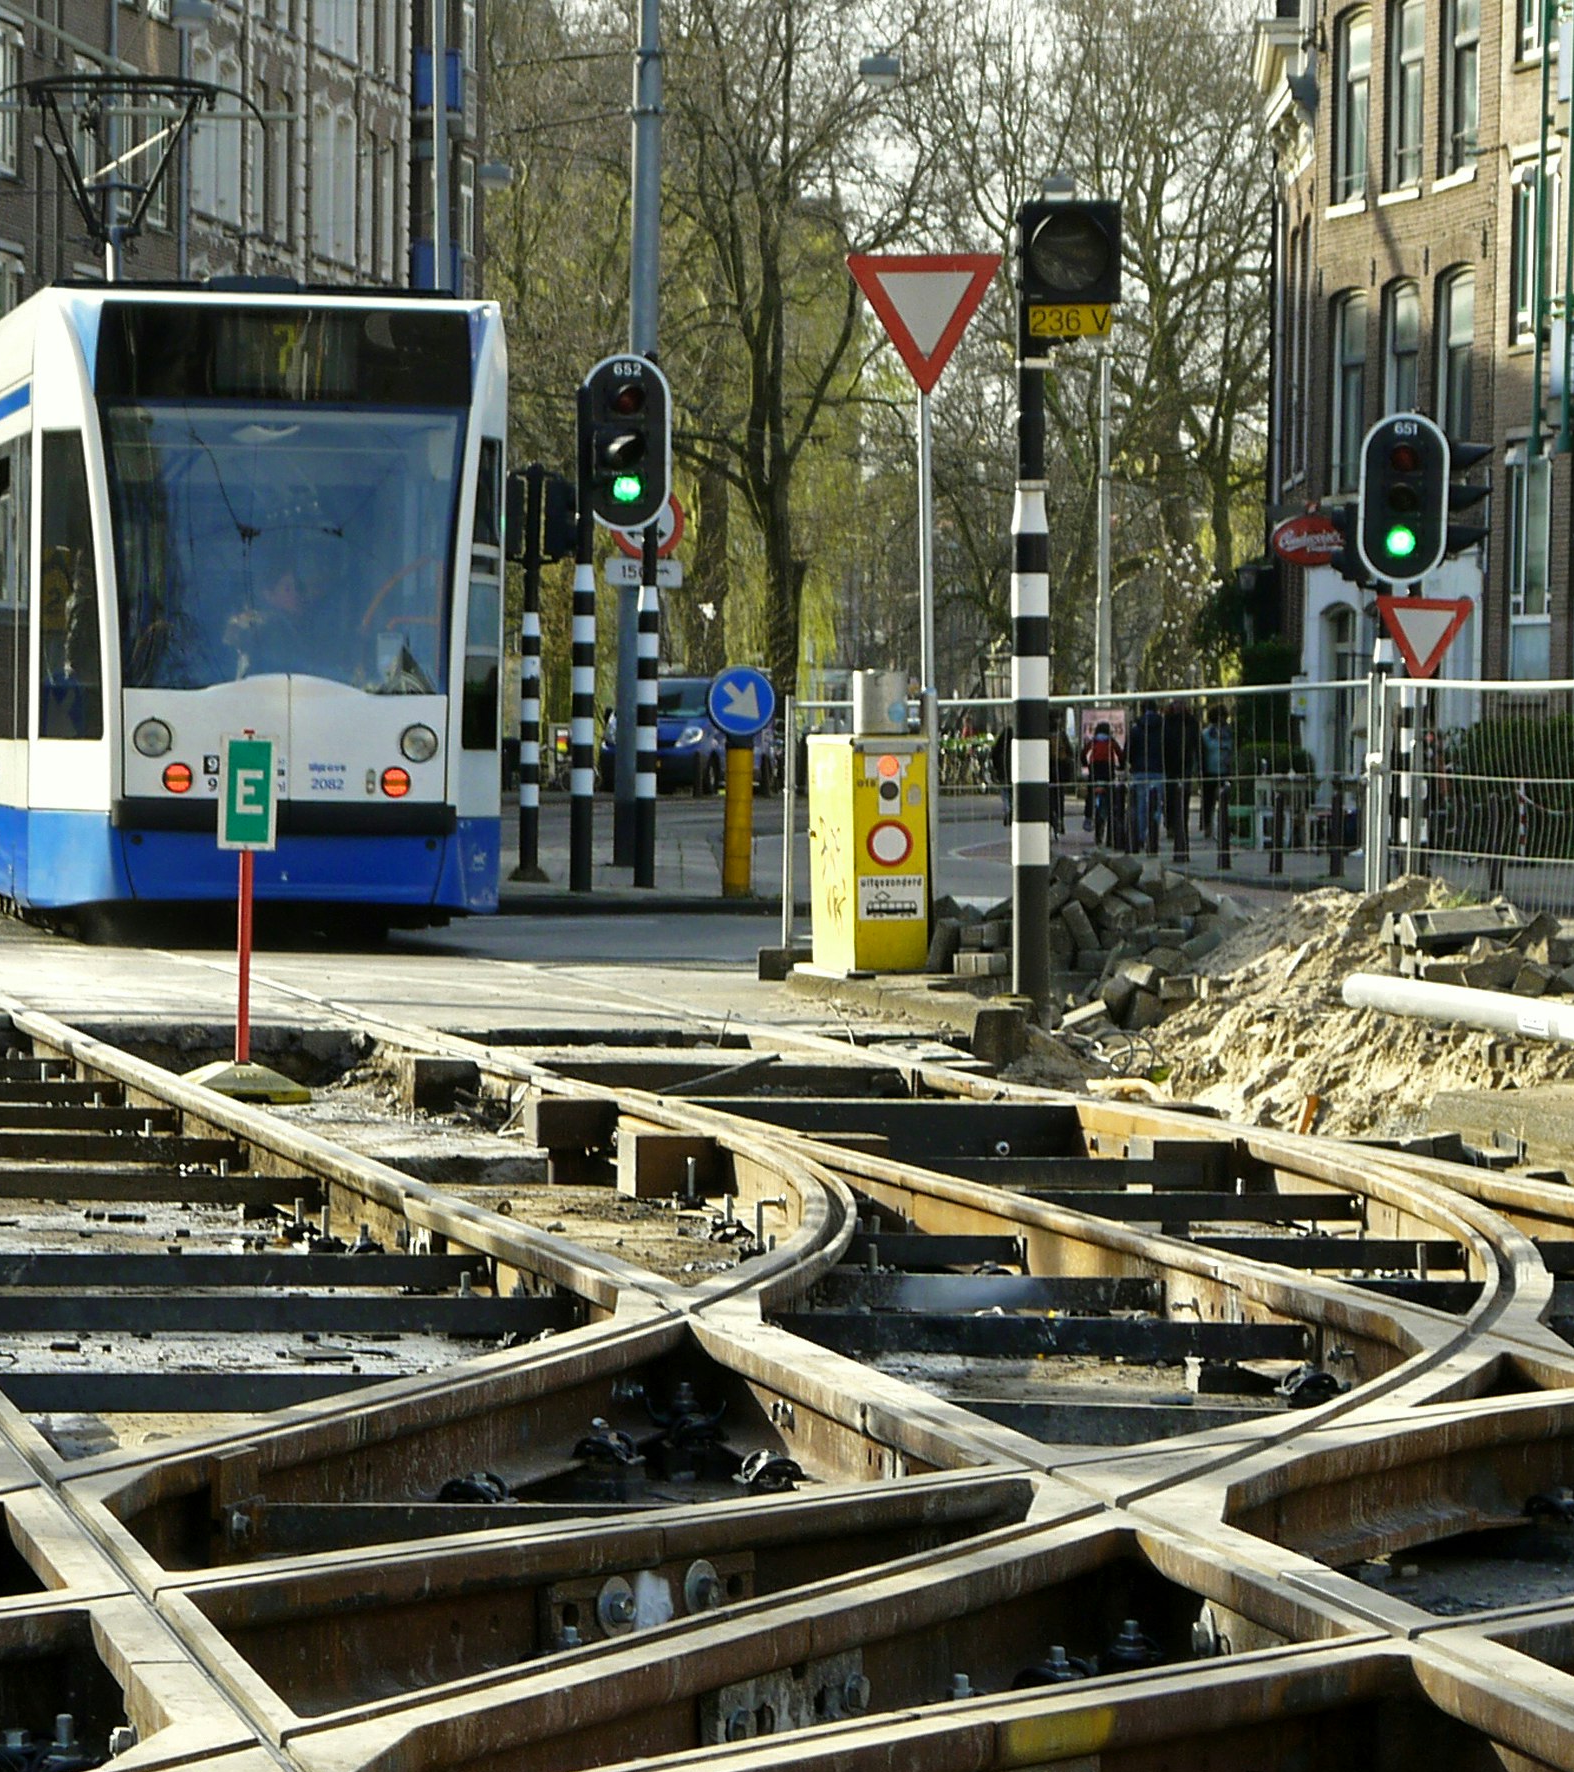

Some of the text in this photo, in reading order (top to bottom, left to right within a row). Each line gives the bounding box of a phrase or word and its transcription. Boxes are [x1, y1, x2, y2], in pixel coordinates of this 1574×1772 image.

[1032, 308, 1110, 332] 236 V
[613, 362, 642, 377] 652
[1394, 422, 1418, 436] 651
[236, 769, 265, 814] E
[311, 778, 345, 791] 2082
[860, 876, 923, 890] uitgezonderd
